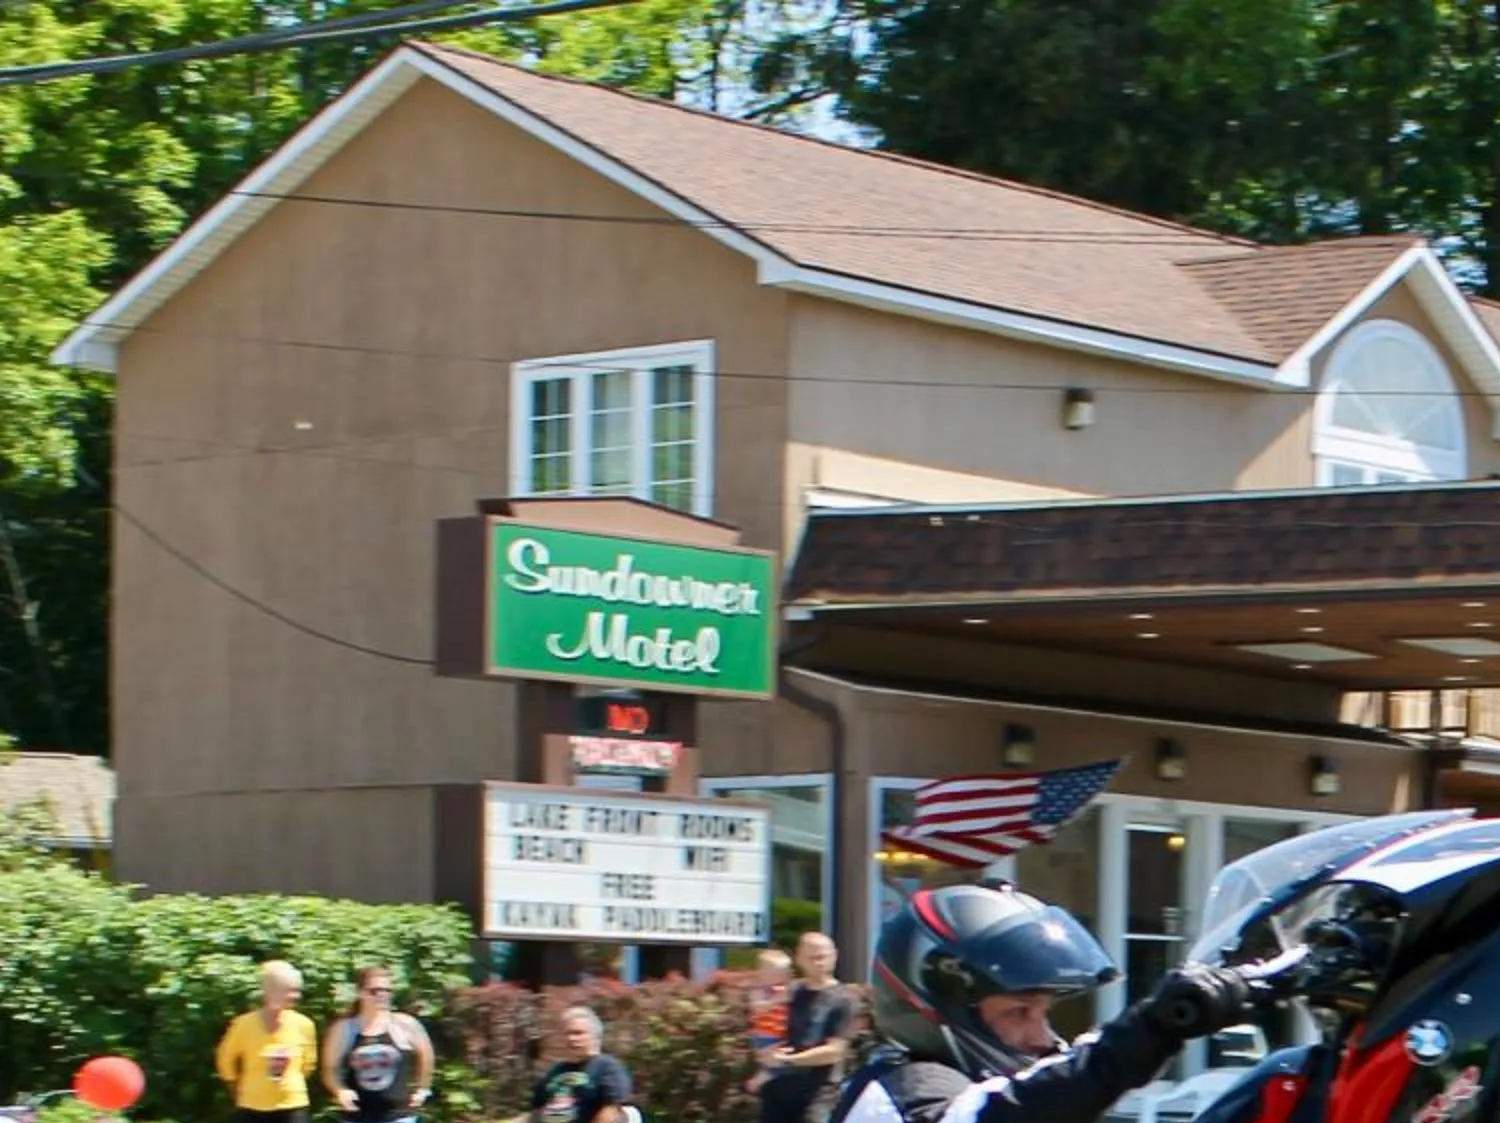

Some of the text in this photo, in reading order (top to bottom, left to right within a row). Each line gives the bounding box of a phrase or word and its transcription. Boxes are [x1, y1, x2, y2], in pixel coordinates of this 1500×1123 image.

[504, 537, 761, 616] Sundowner
[545, 611, 721, 674] Motel
[508, 803, 754, 842] LAKE FRONT ROOMS
[513, 834, 584, 864] BEACH
[603, 872, 655, 900] FREE
